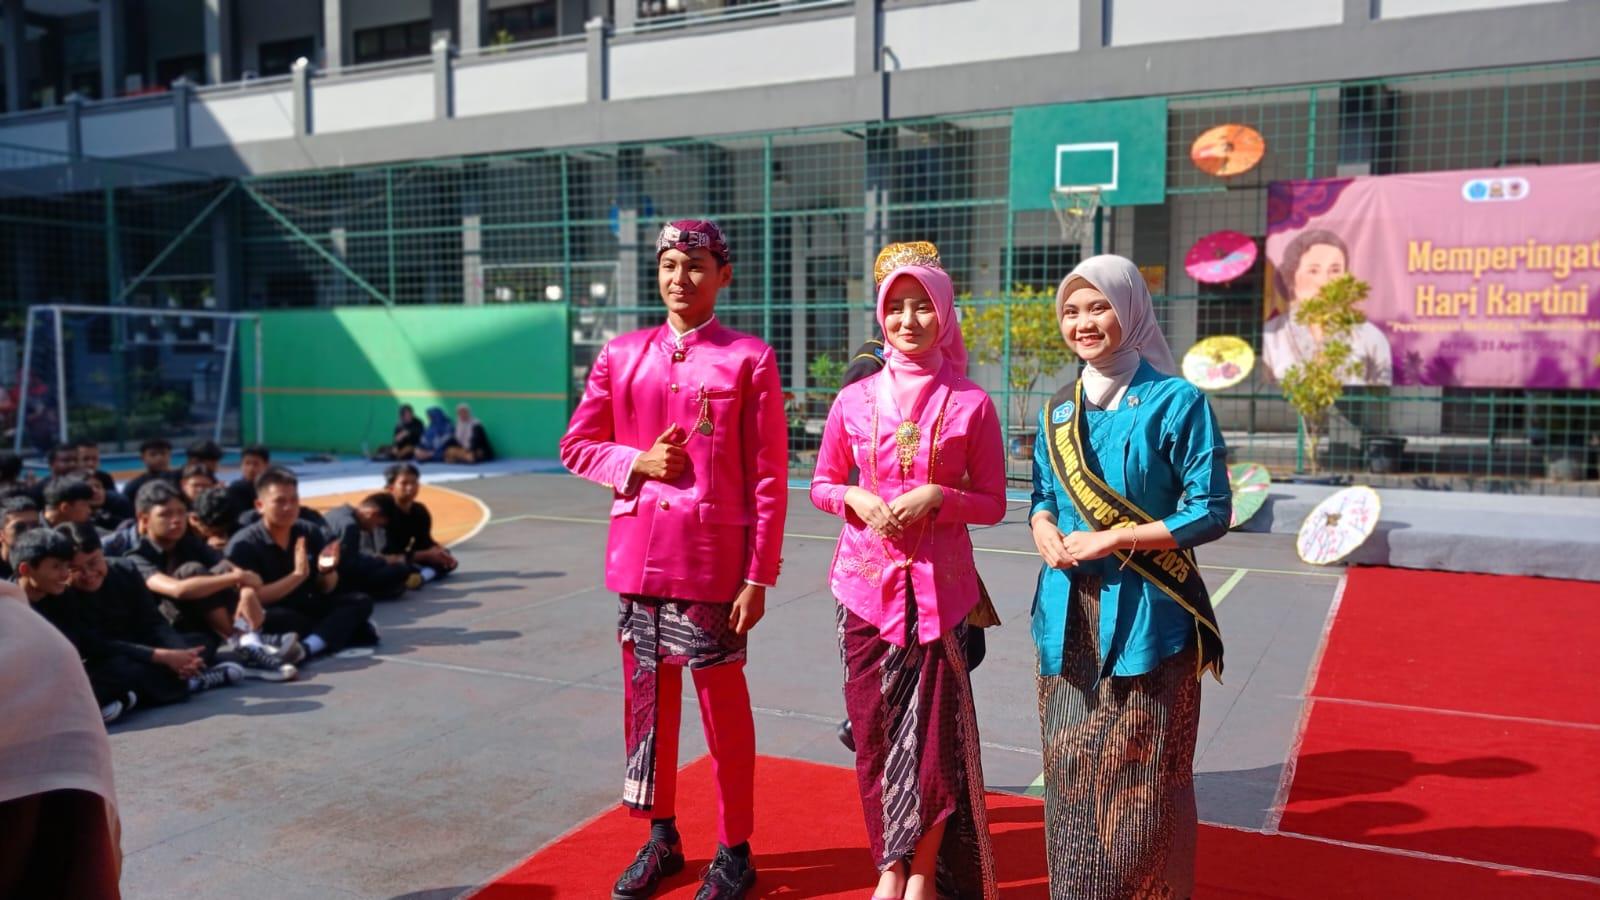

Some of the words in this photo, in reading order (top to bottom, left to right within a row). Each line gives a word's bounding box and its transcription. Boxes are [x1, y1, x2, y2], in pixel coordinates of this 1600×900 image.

[1408, 239, 1600, 280] Memperingat
[1416, 284, 1478, 317] Hari
[1486, 283, 1590, 316] Kartini
[1069, 470, 1120, 526] CAMPUS
